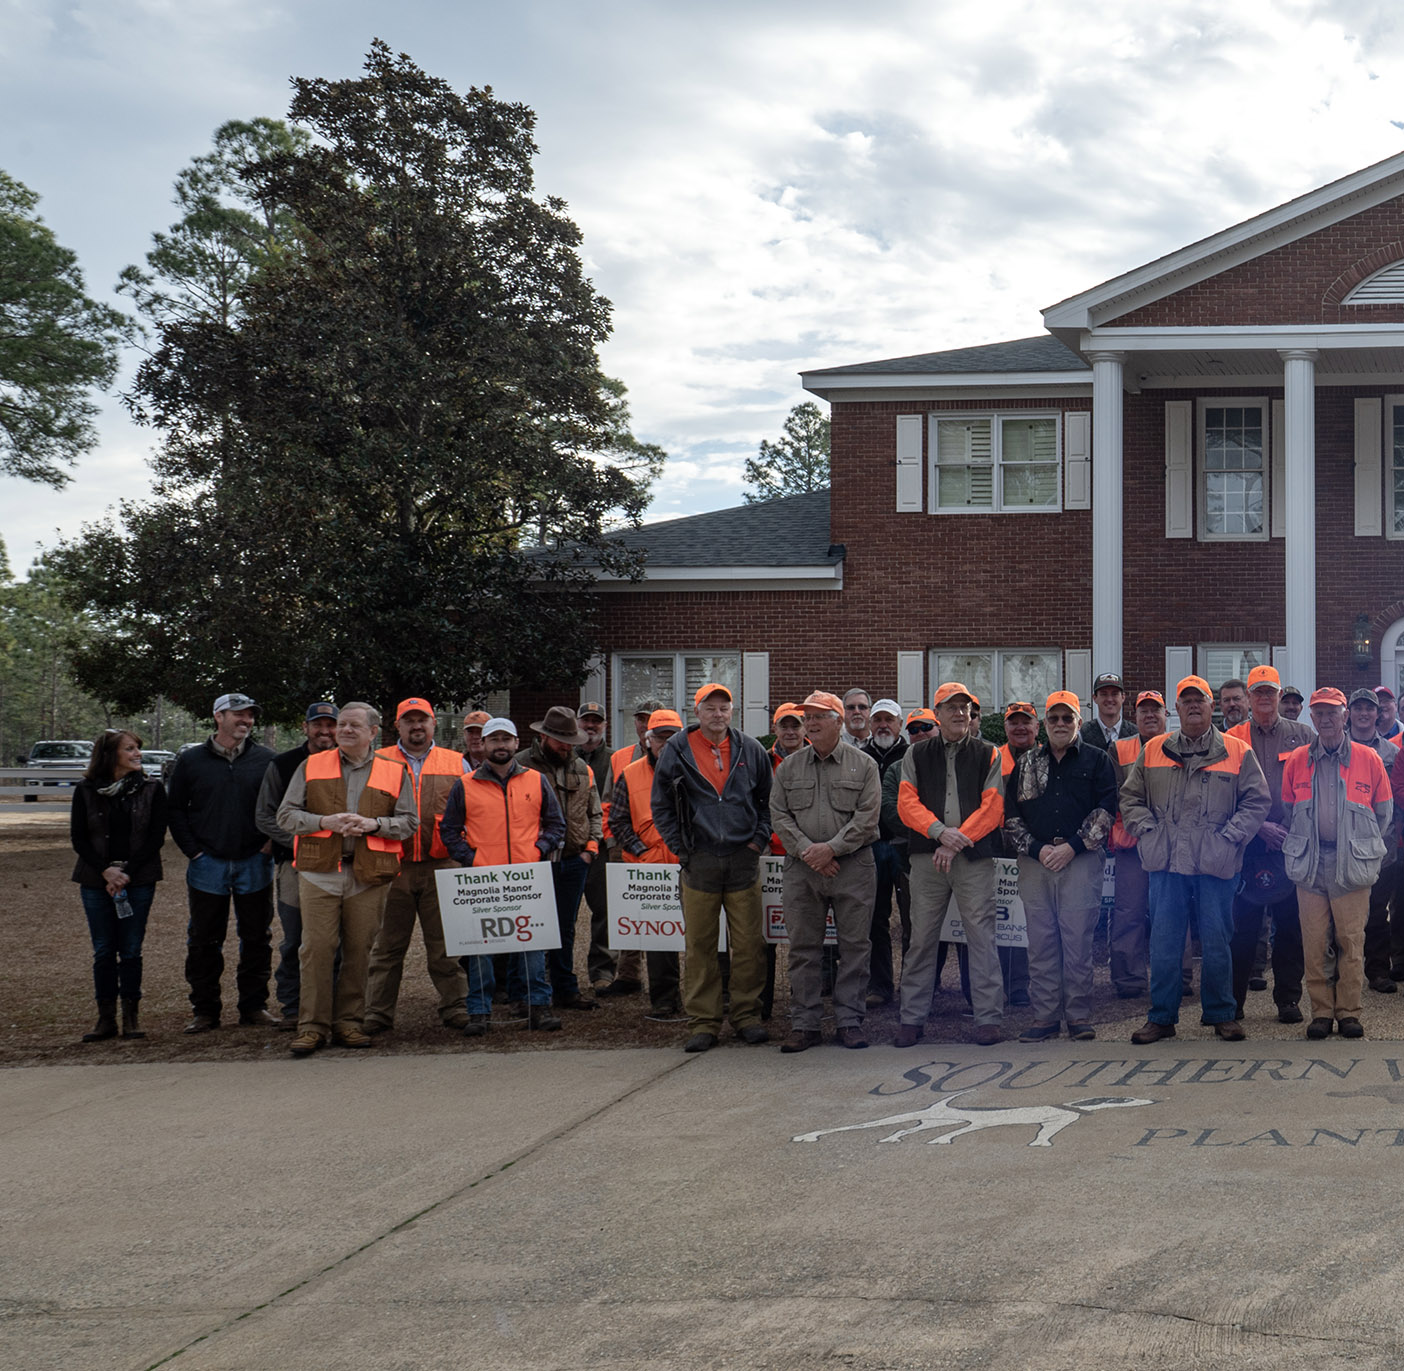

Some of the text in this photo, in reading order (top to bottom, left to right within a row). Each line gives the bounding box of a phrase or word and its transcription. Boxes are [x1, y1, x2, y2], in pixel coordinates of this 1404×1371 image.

[627, 869, 672, 881] Thank
[1002, 863, 1019, 876] Yo
[454, 869, 534, 885] Thank You!
[457, 884, 533, 897] Magnolia Manor
[628, 884, 672, 893] Magnolia
[453, 892, 542, 906] Corporate Sponsor
[622, 892, 671, 901] Corporate
[472, 904, 522, 914] Silver Sponsor
[662, 903, 681, 911] Spon
[617, 916, 685, 936] SYNOV
[868, 1058, 1366, 1096] SOUTHERN
